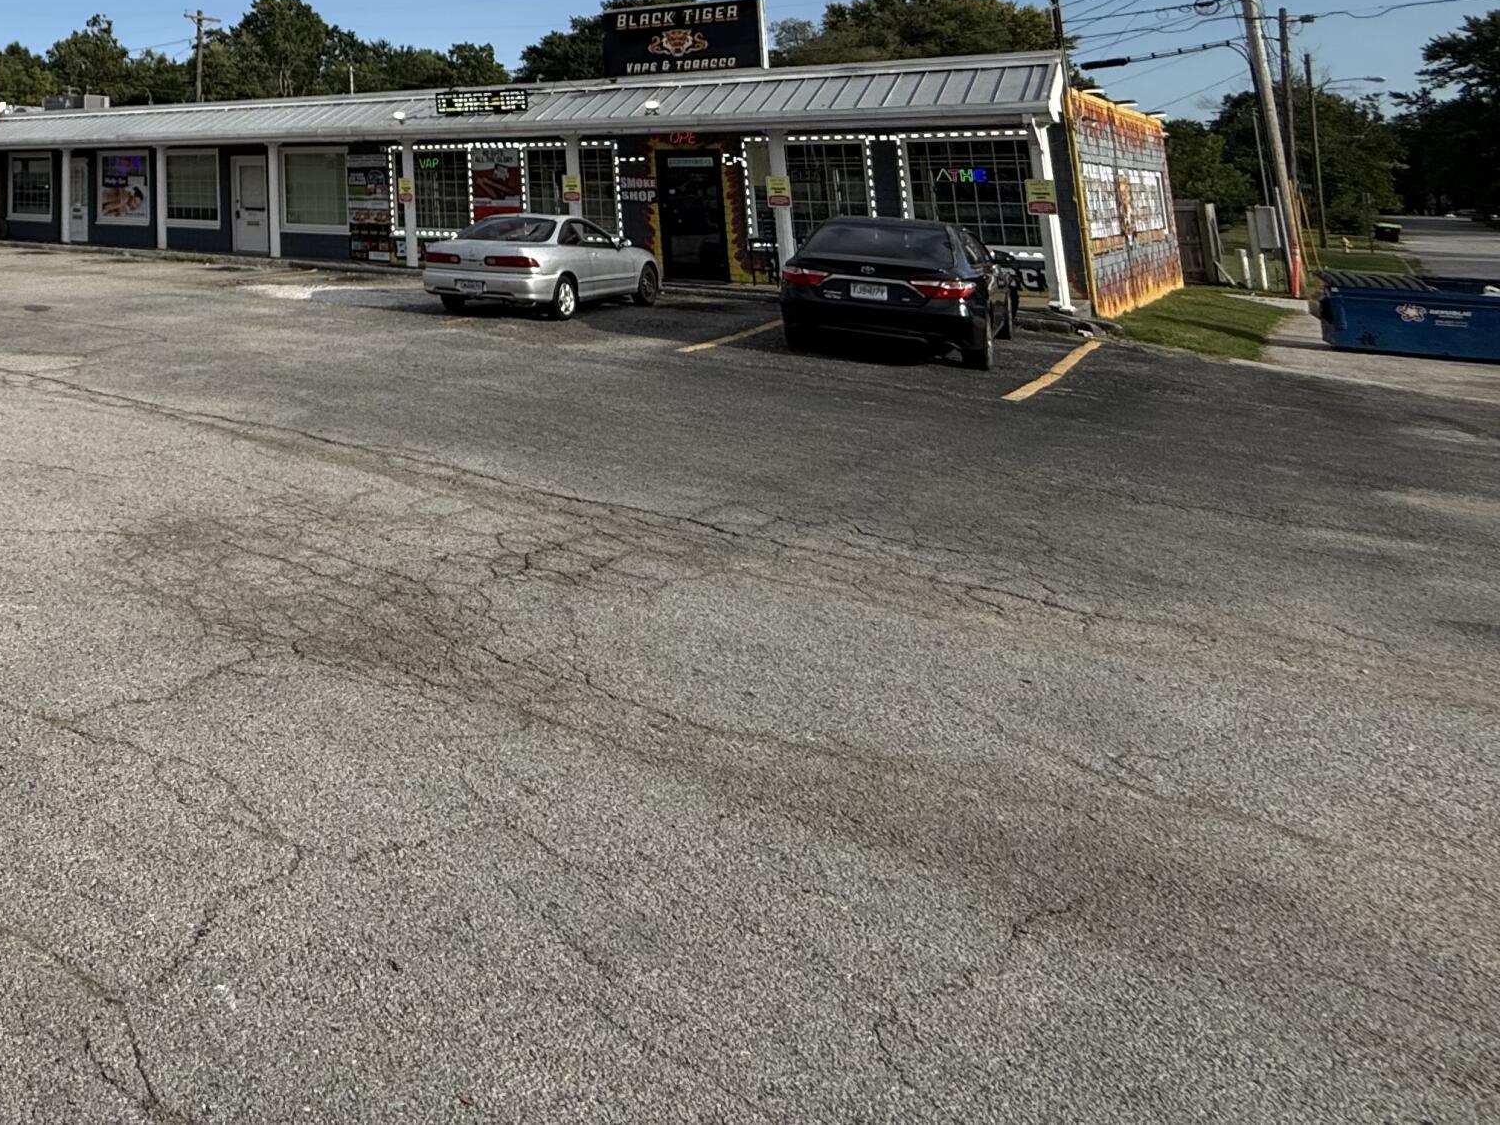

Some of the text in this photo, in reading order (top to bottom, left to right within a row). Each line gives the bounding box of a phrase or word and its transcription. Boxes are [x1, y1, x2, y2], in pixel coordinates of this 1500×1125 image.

[617, 5, 739, 29] BLACK TIGER
[626, 57, 736, 74] VAPE & TOBACCO
[620, 176, 657, 188] SMOKE
[621, 190, 656, 203] SHOP
